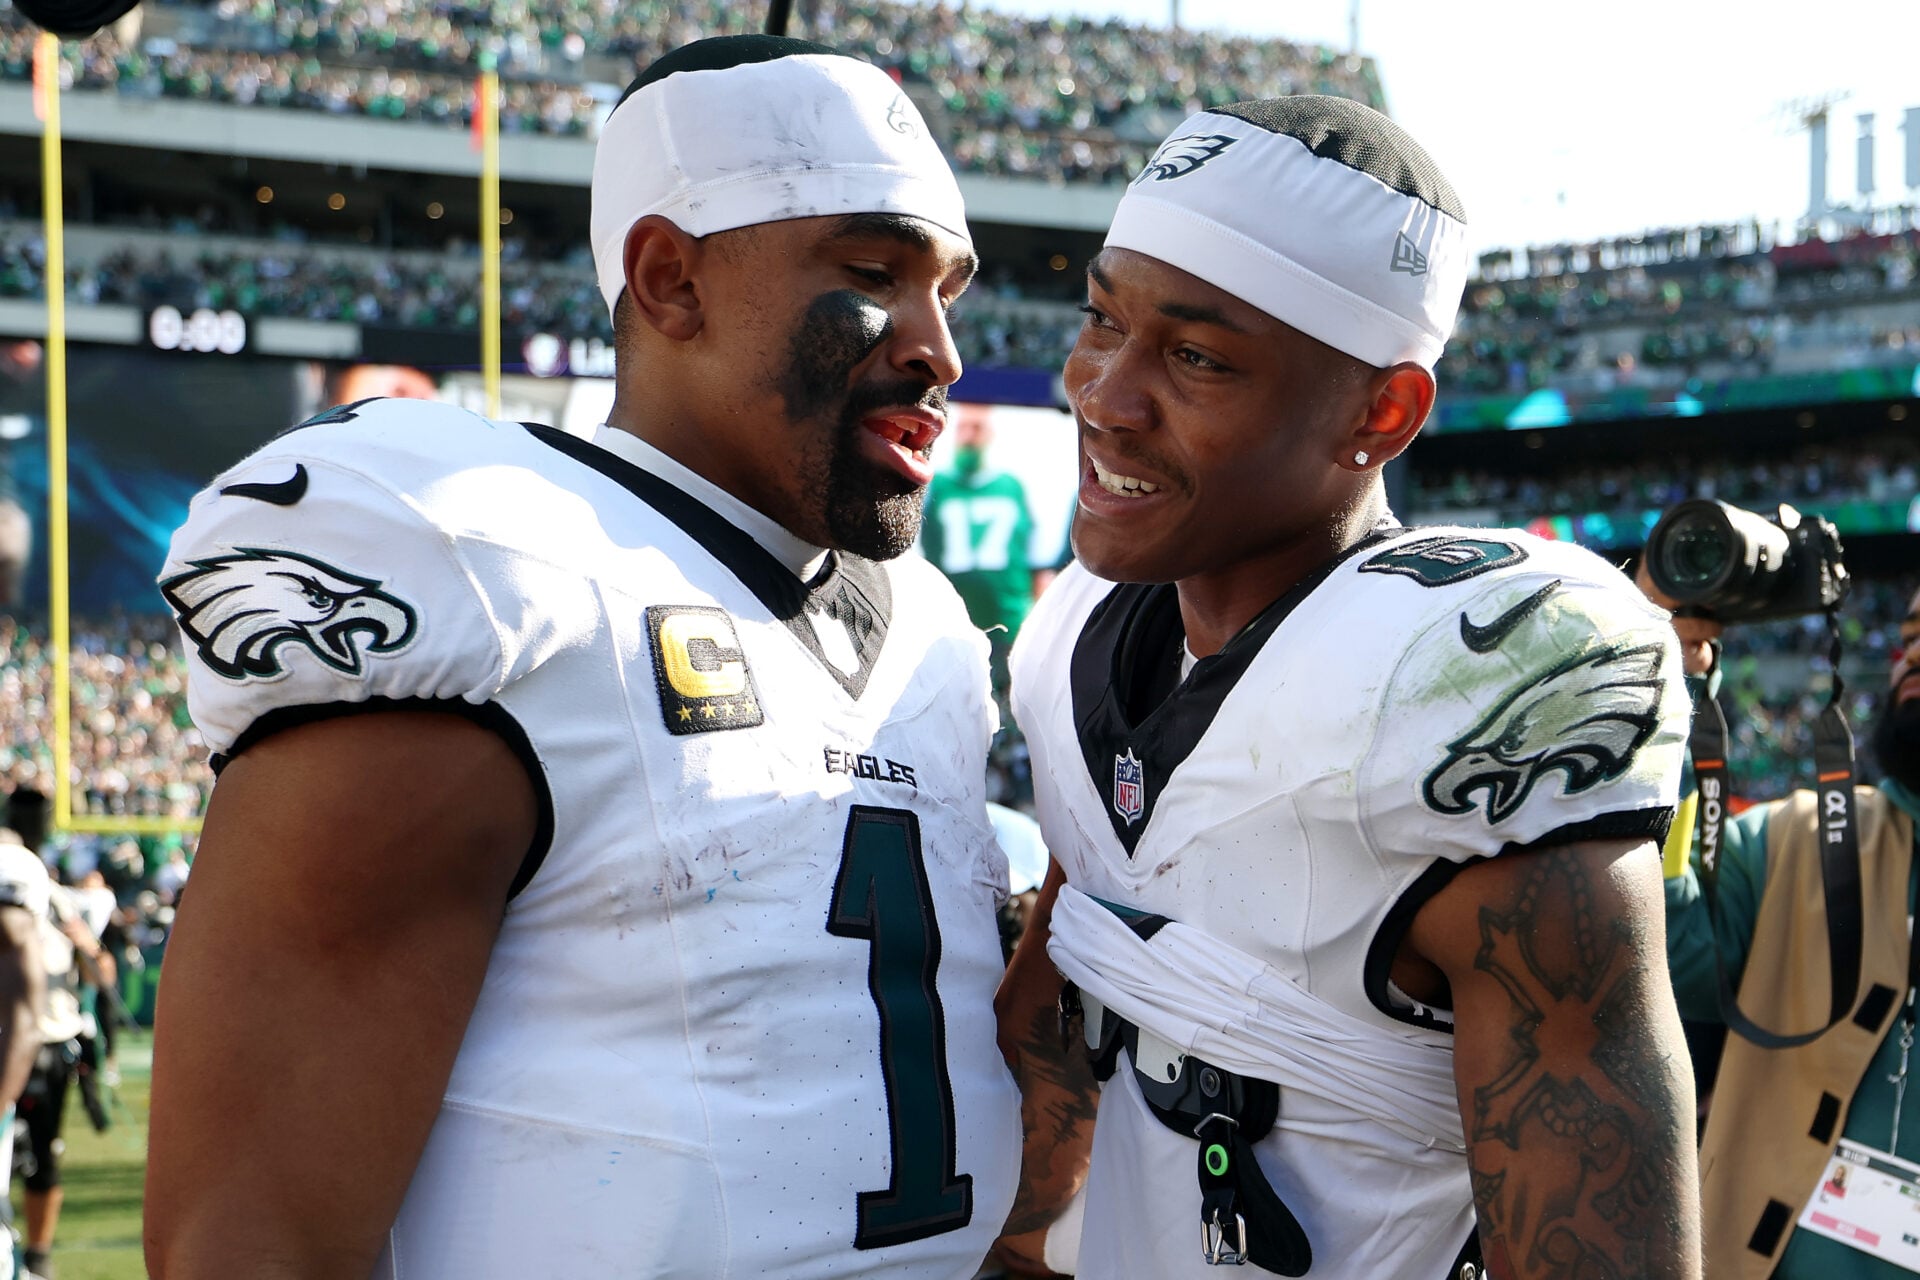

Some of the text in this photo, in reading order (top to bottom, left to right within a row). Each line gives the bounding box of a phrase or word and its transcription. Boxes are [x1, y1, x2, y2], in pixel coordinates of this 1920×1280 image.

[150, 304, 246, 355] 0:00
[938, 497, 1020, 574] 17
[660, 613, 747, 698] C
[824, 746, 917, 788] EAGLES
[1118, 782, 1140, 812] NFL
[1701, 776, 1721, 872] SONY
[826, 804, 973, 1250] 1
